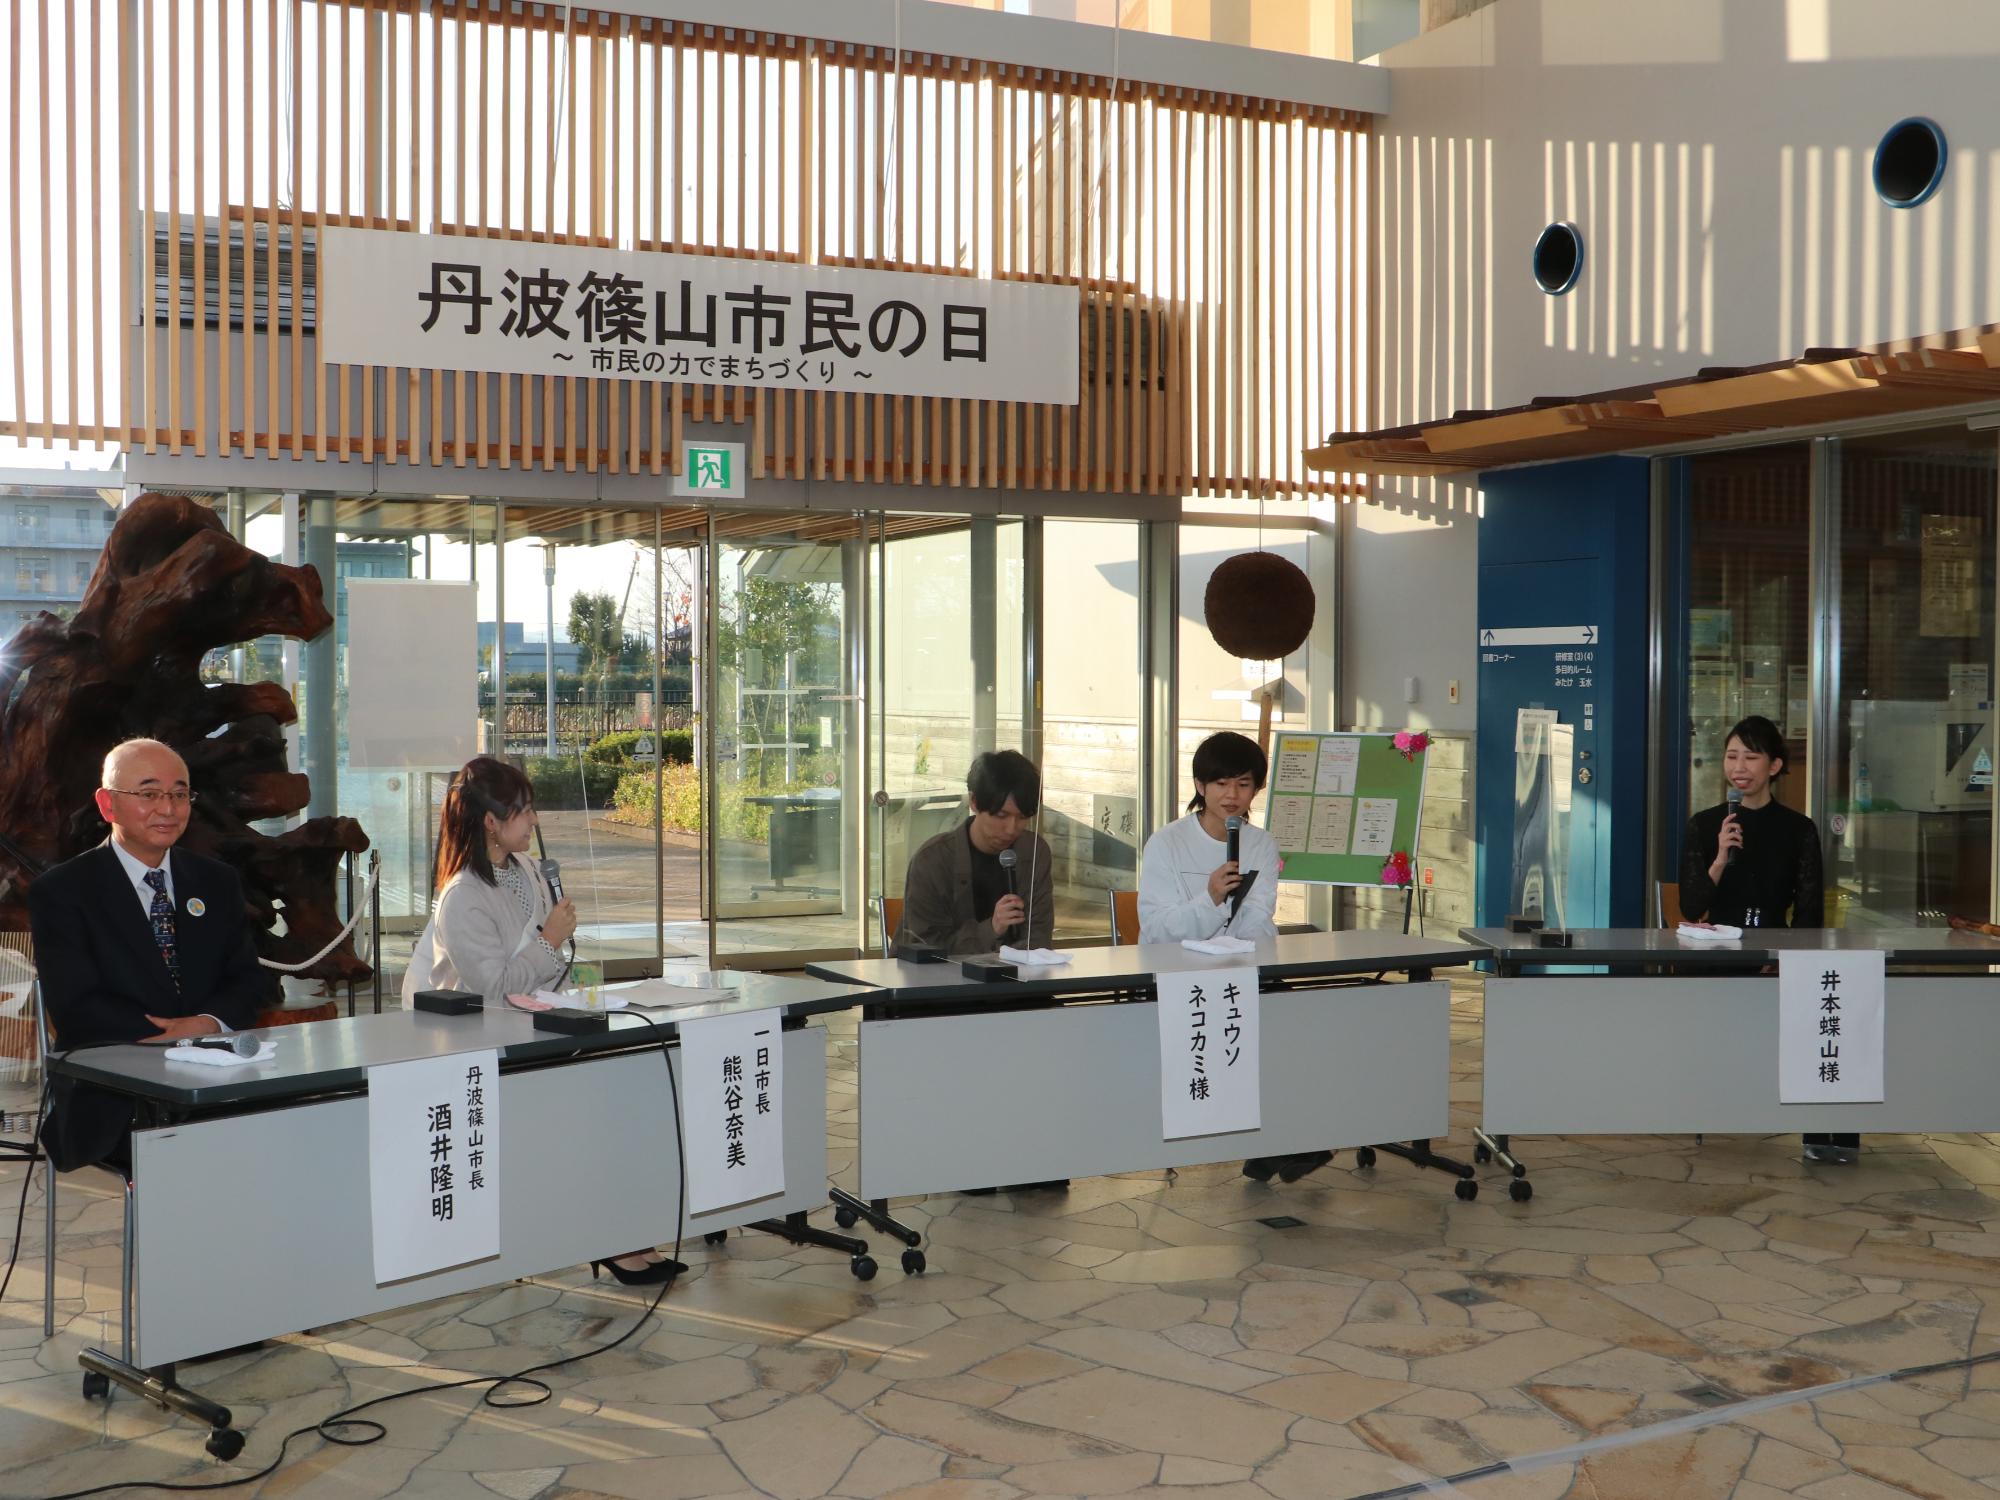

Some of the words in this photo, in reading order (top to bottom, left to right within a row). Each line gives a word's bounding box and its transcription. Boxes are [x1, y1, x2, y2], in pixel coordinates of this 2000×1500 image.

[418, 261, 988, 363] 丹波篠山市民の日
[1555, 665, 1592, 674] 多目的ルーム
[753, 1029, 771, 1115] 一日市長
[1189, 985, 1210, 1101] ネコカミ様
[1223, 983, 1242, 1067] キュウソ
[1818, 970, 1841, 1083] 井本蝶山様
[427, 1103, 454, 1222] 酒井隆明
[465, 1065, 485, 1191] 丹波篠山市長
[722, 1056, 746, 1169] 熊谷奈美
